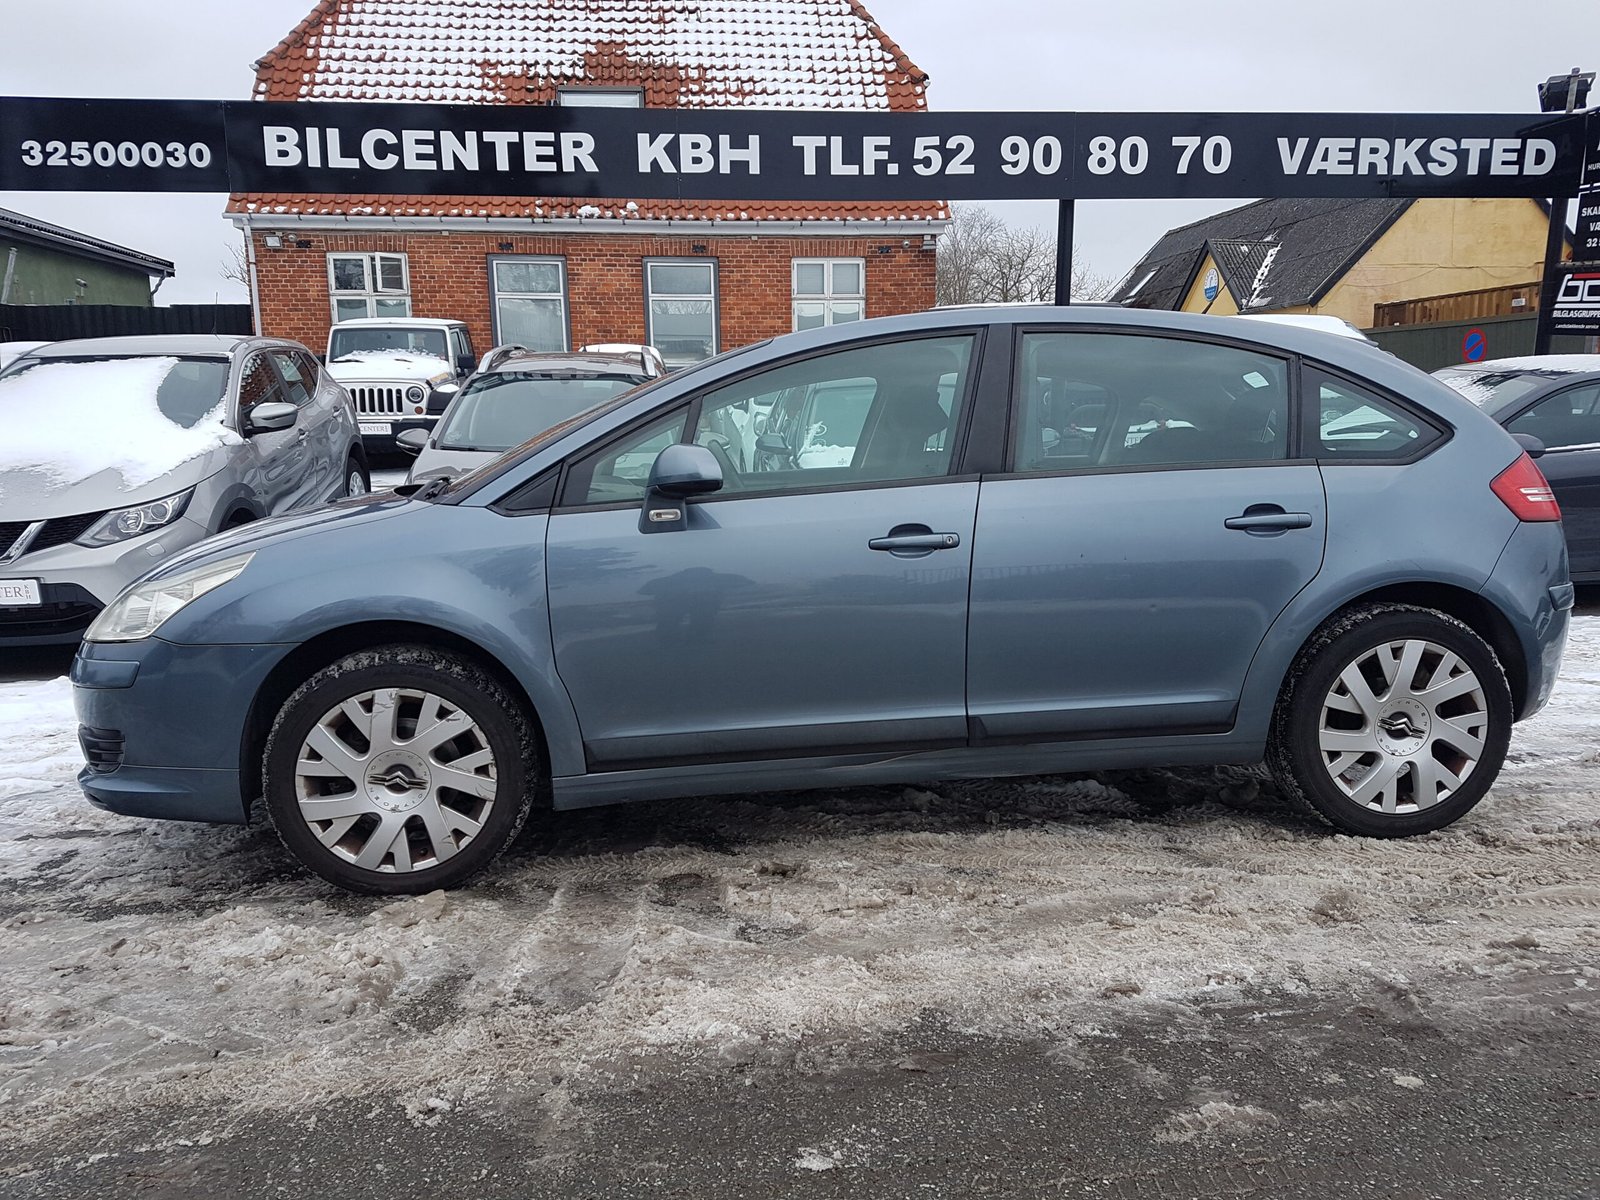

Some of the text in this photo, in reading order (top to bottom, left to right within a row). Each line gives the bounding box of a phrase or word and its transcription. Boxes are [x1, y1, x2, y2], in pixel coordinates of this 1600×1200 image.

[21, 140, 212, 168] 32500030
[262, 126, 1232, 176] BILCENTER KBH TLF. 52 90 80 70
[1276, 137, 1557, 176] VÆRKSTED
